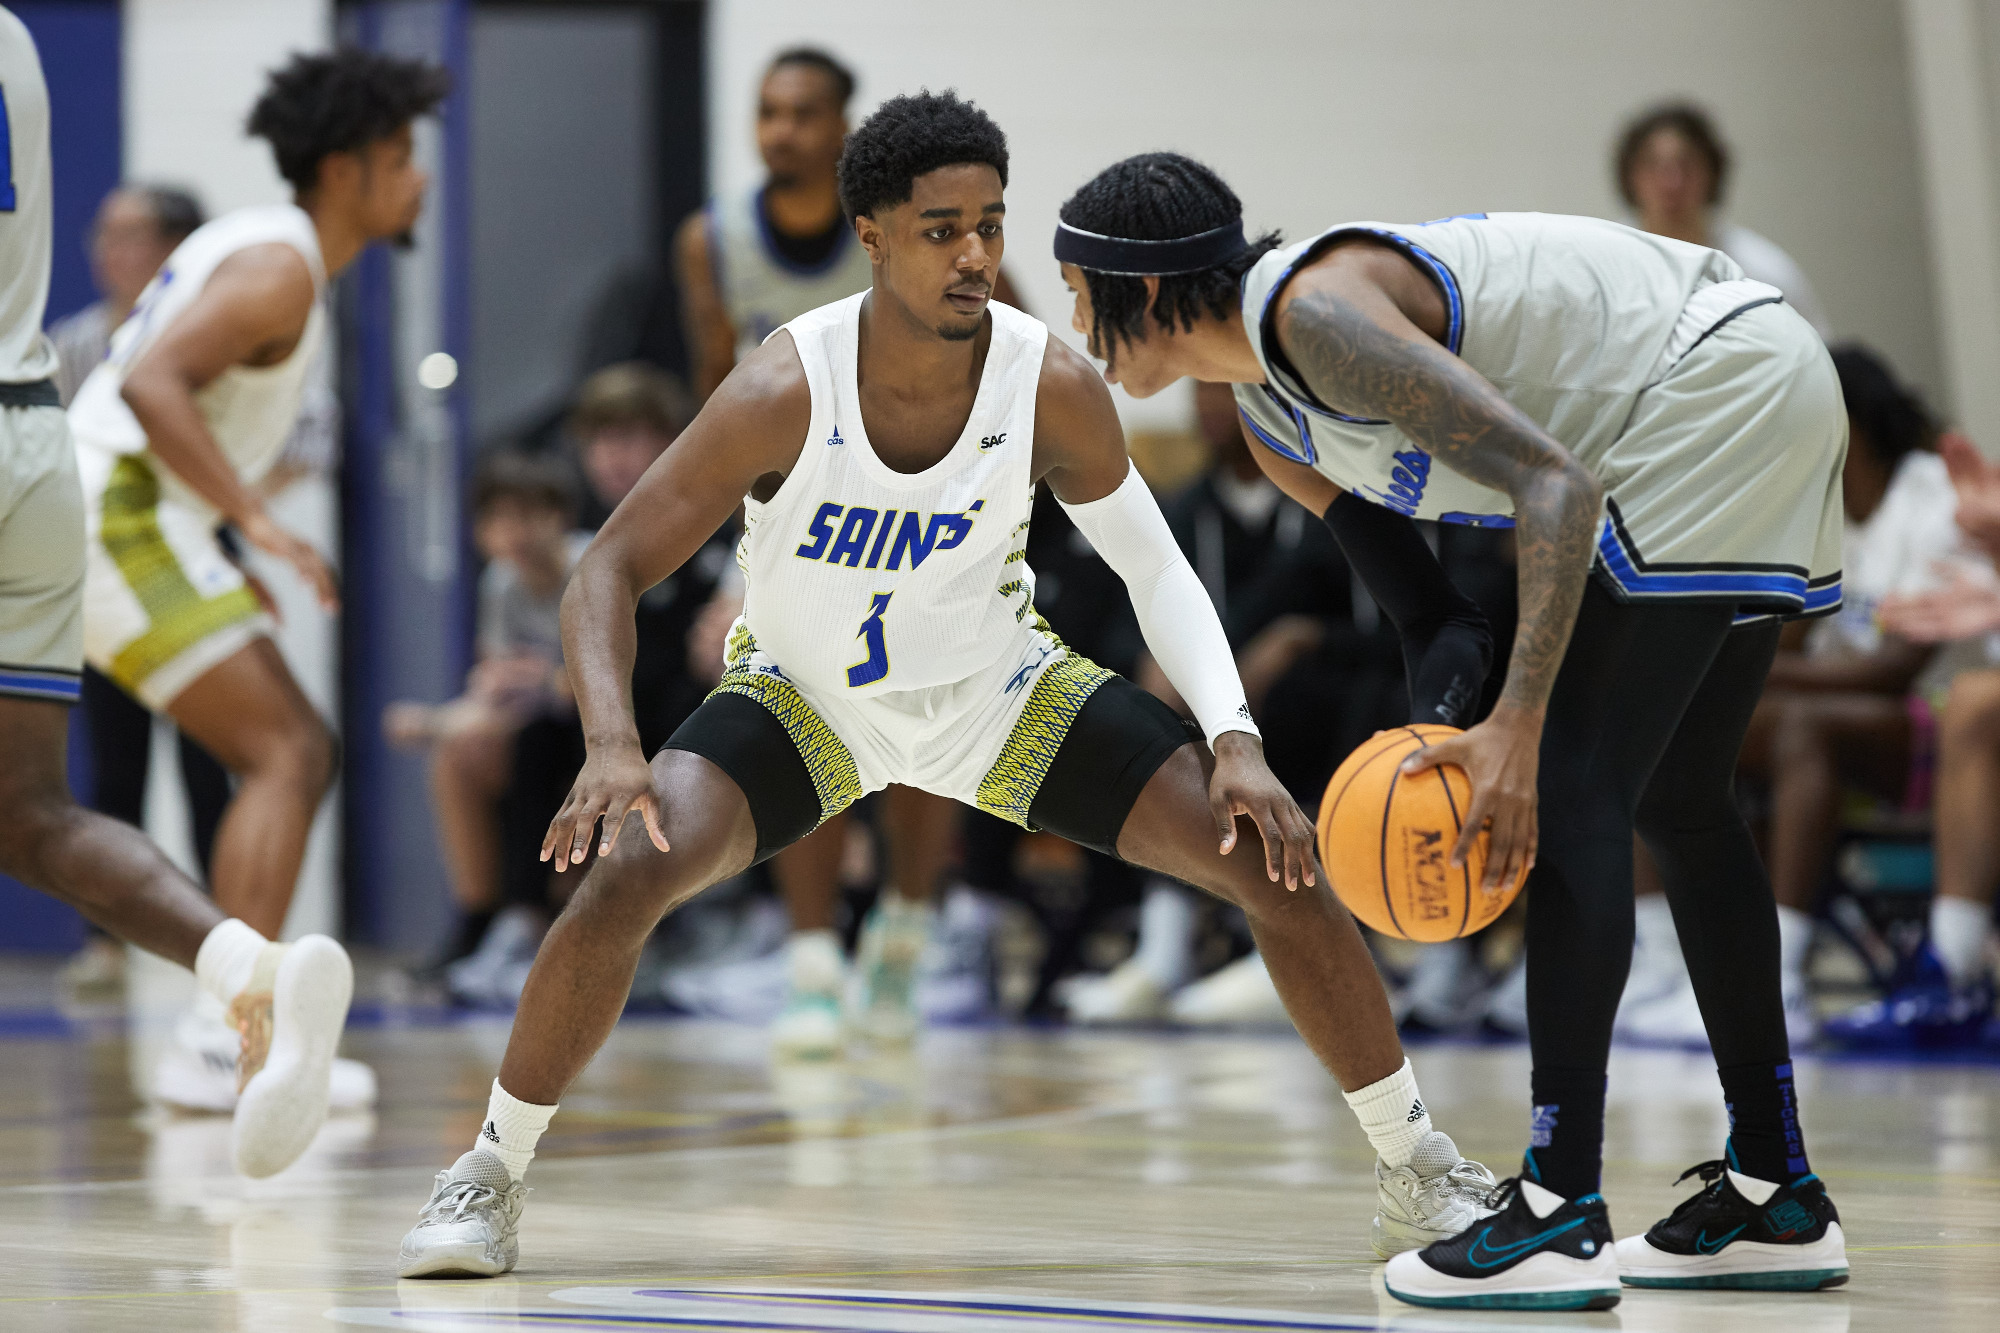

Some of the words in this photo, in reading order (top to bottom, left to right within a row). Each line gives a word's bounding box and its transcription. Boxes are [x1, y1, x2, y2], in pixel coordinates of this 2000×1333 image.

[980, 433, 1007, 449] SAC
[795, 499, 987, 571] SAINS
[1778, 1083, 1802, 1155] TIGERS
